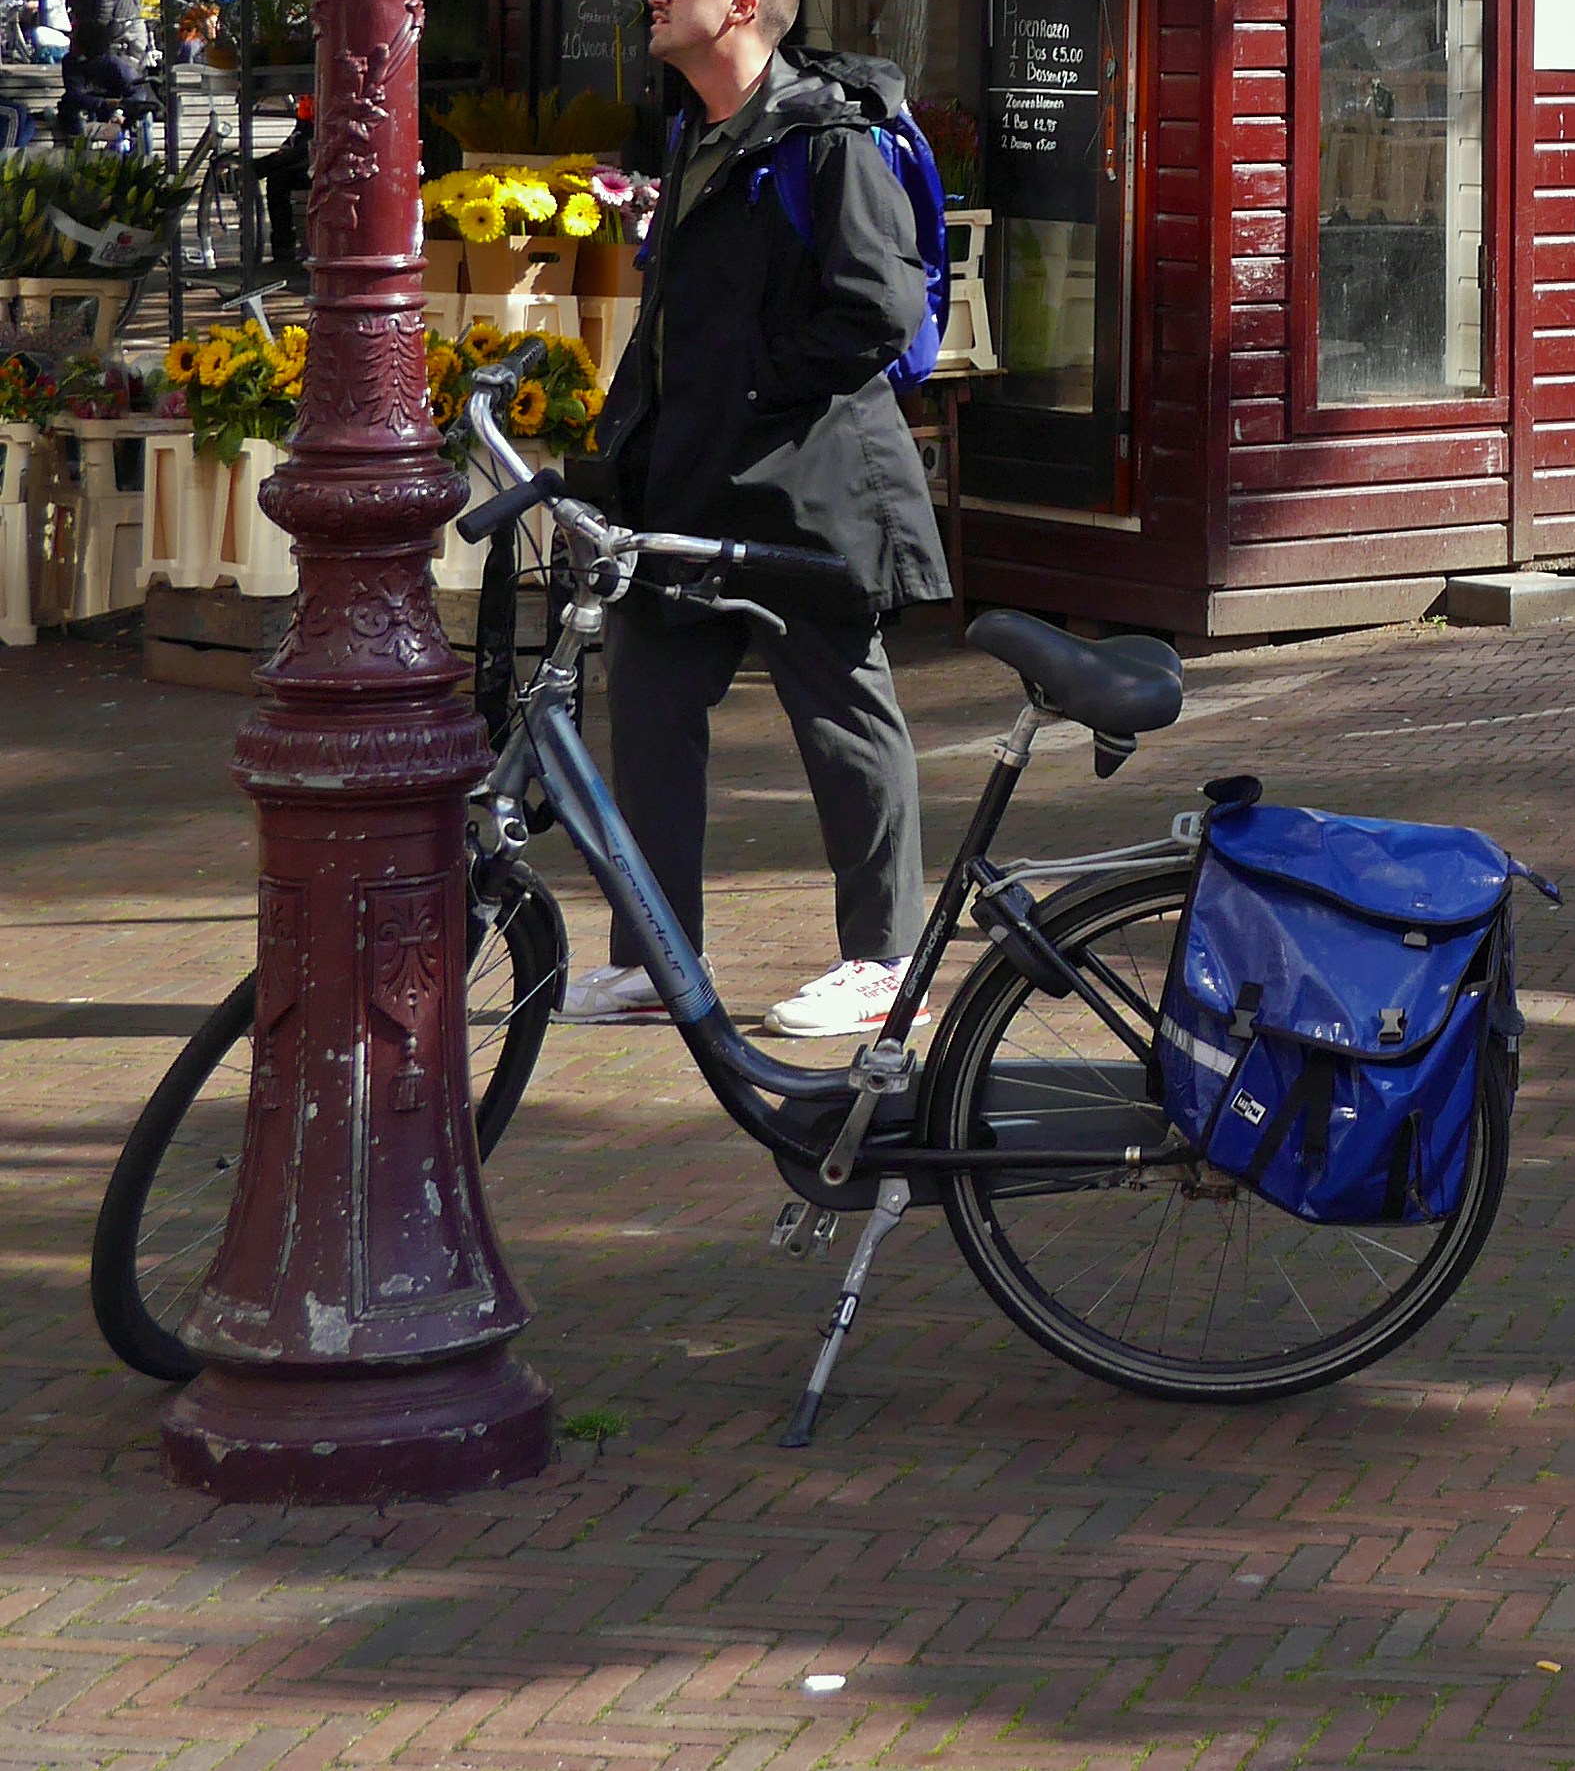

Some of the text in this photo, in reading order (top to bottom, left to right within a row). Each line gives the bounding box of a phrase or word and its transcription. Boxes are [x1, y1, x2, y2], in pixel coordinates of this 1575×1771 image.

[1009, 39, 1019, 59] 1
[1027, 39, 1047, 60] Bos
[1002, 113, 1010, 128] 1
[1014, 113, 1029, 129] Bos
[612, 854, 686, 979] Grandeur
